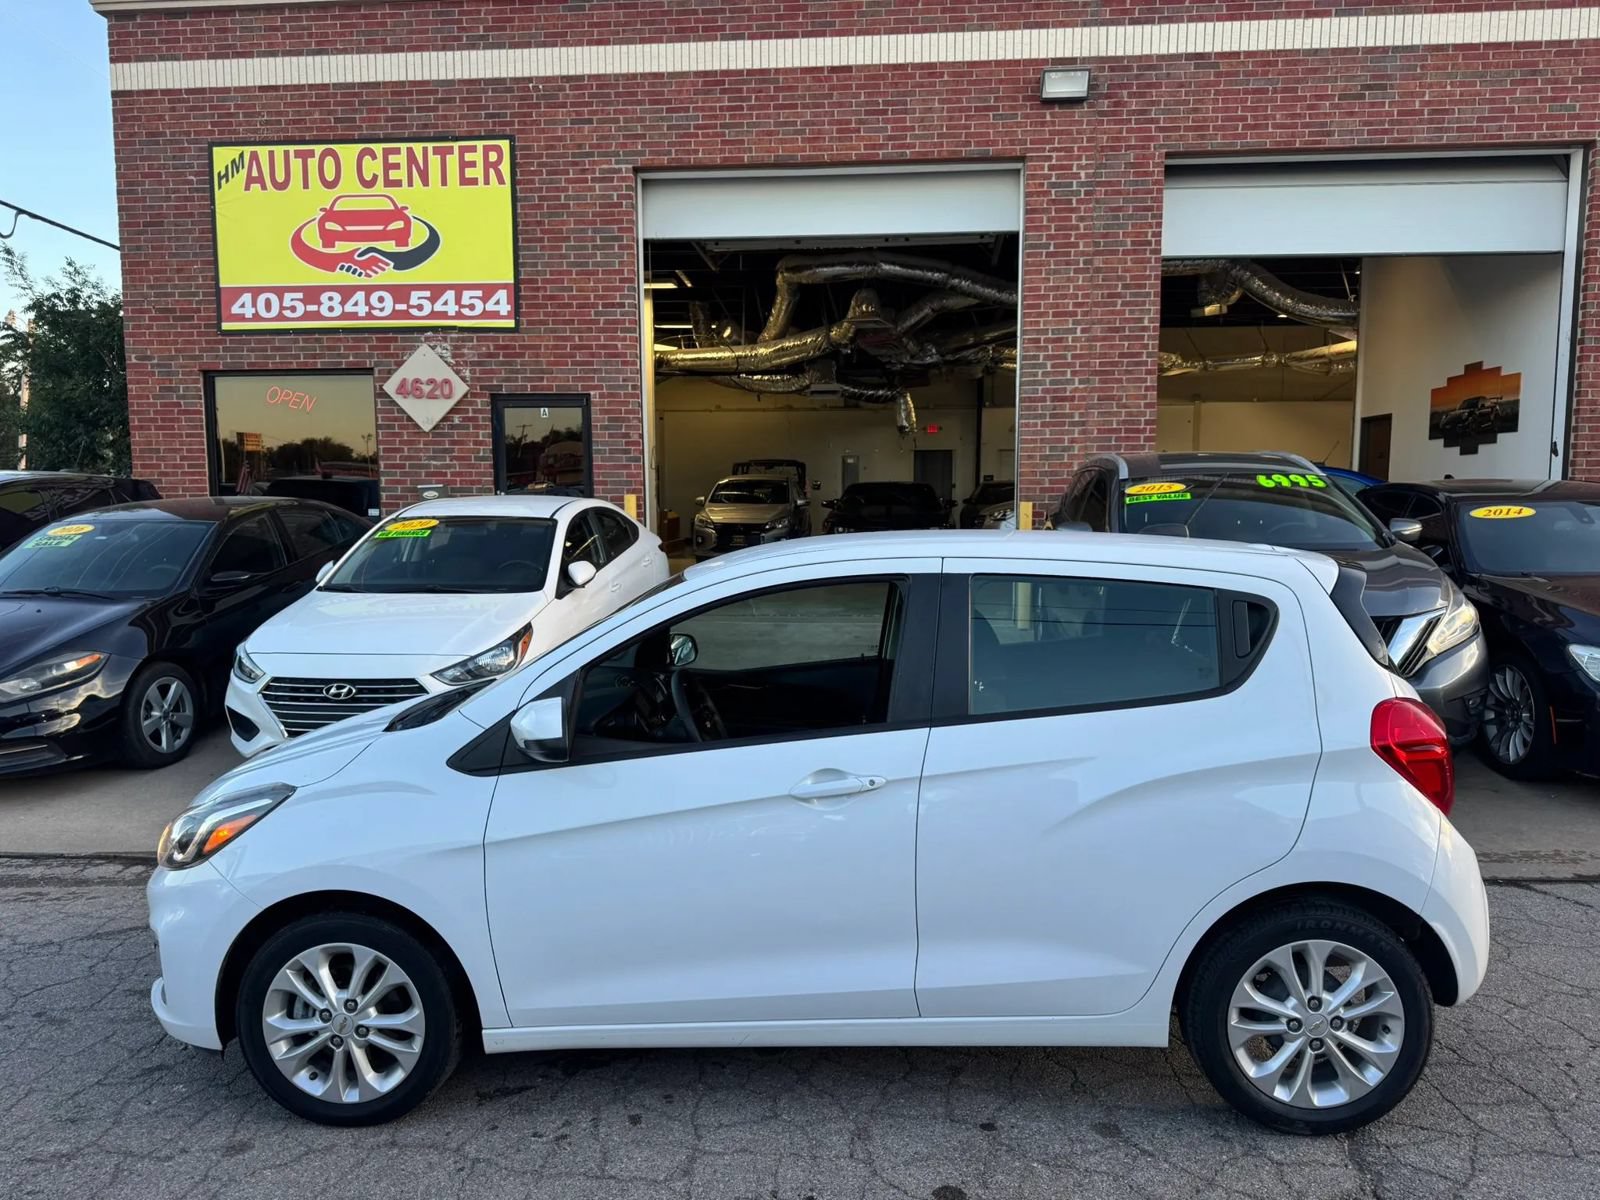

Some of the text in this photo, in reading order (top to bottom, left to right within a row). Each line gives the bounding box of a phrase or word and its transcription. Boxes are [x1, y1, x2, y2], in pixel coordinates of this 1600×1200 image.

[217, 144, 506, 192] HM AUTO CENTER
[231, 289, 511, 319] 405-849-5454
[395, 377, 454, 400] 4620
[266, 386, 317, 412] OPEN
[1135, 484, 1175, 493] 2015
[1256, 473, 1327, 488] 6995
[1156, 492, 1188, 500] VALUE
[1482, 507, 1524, 517] 2014
